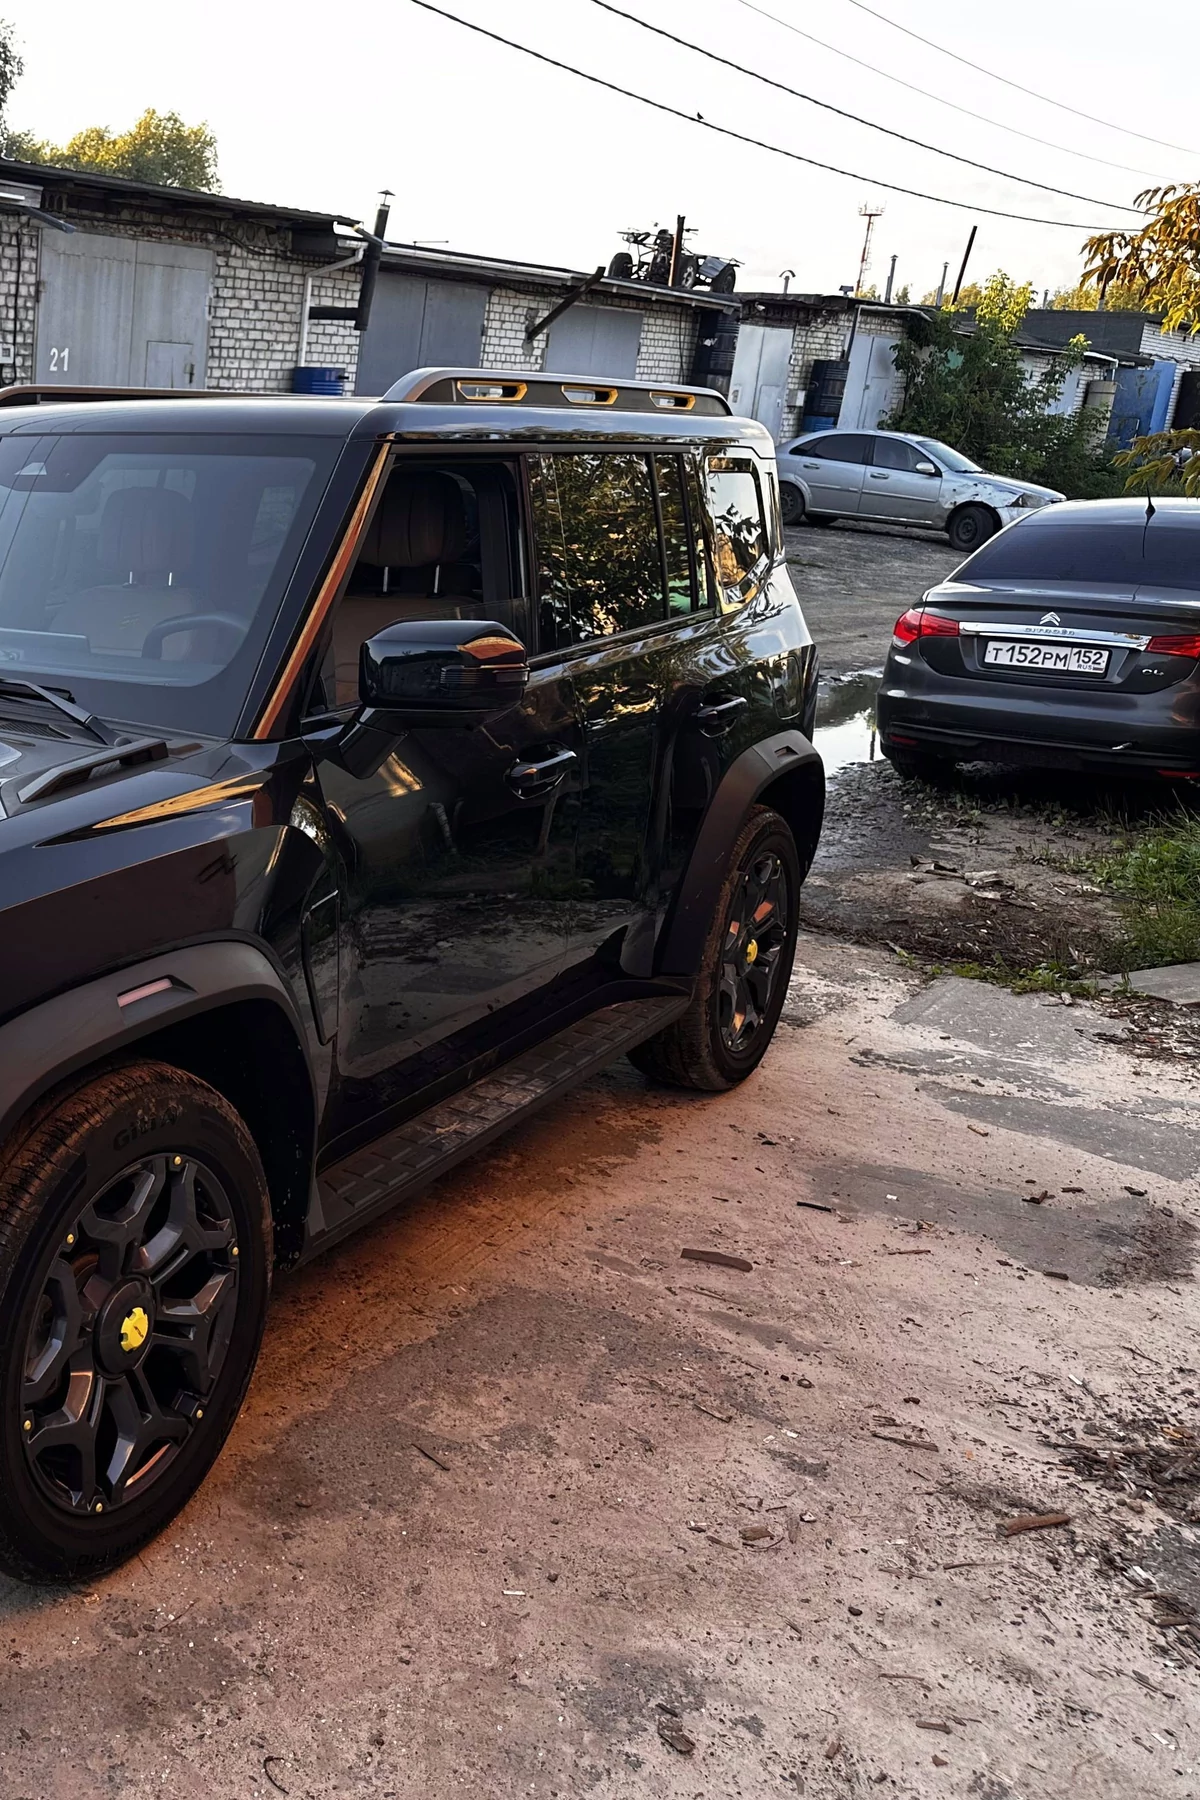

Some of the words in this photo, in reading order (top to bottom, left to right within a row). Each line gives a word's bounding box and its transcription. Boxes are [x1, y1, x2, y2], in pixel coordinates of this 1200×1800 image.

[49, 347, 70, 372] 21
[1073, 649, 1103, 666] 152
[1076, 663, 1093, 671] RUS
